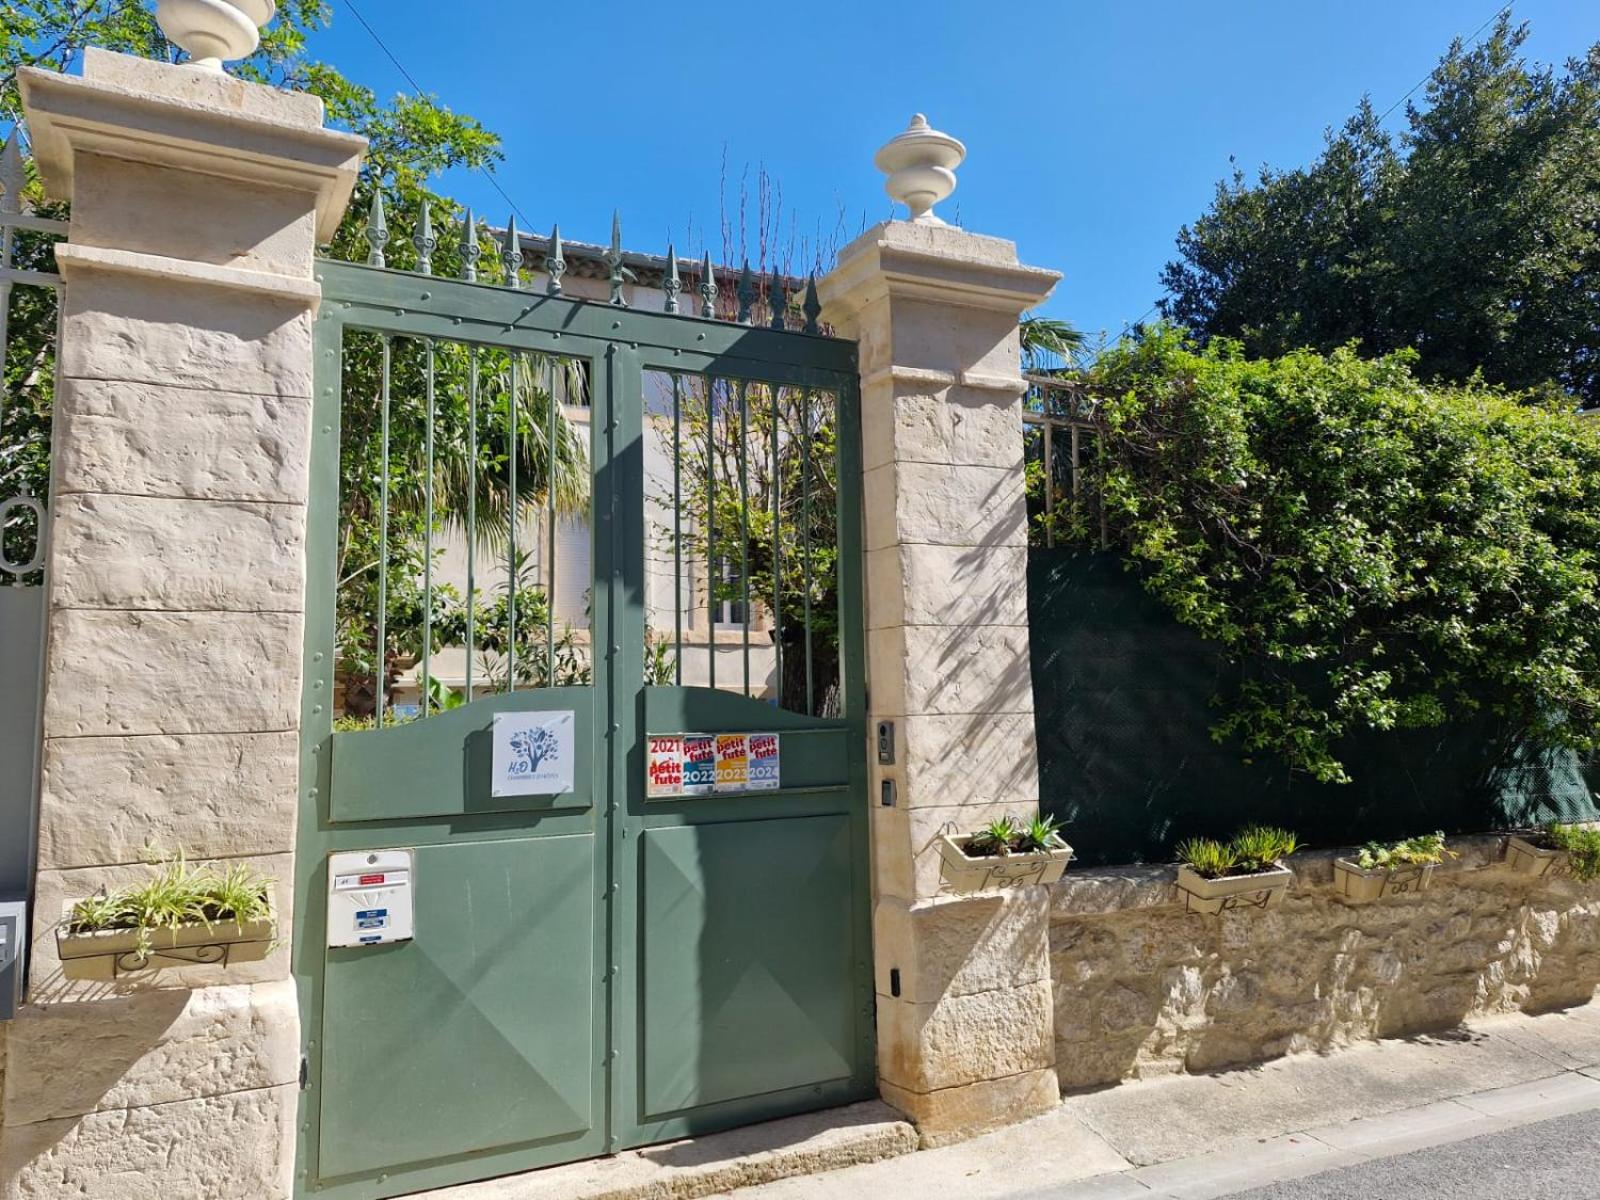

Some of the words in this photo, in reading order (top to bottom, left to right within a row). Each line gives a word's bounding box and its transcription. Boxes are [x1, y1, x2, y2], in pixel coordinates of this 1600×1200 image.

[650, 739, 680, 753] 2021
[683, 740, 712, 756] petit
[649, 761, 681, 777] petit
[683, 771, 714, 782] 2022
